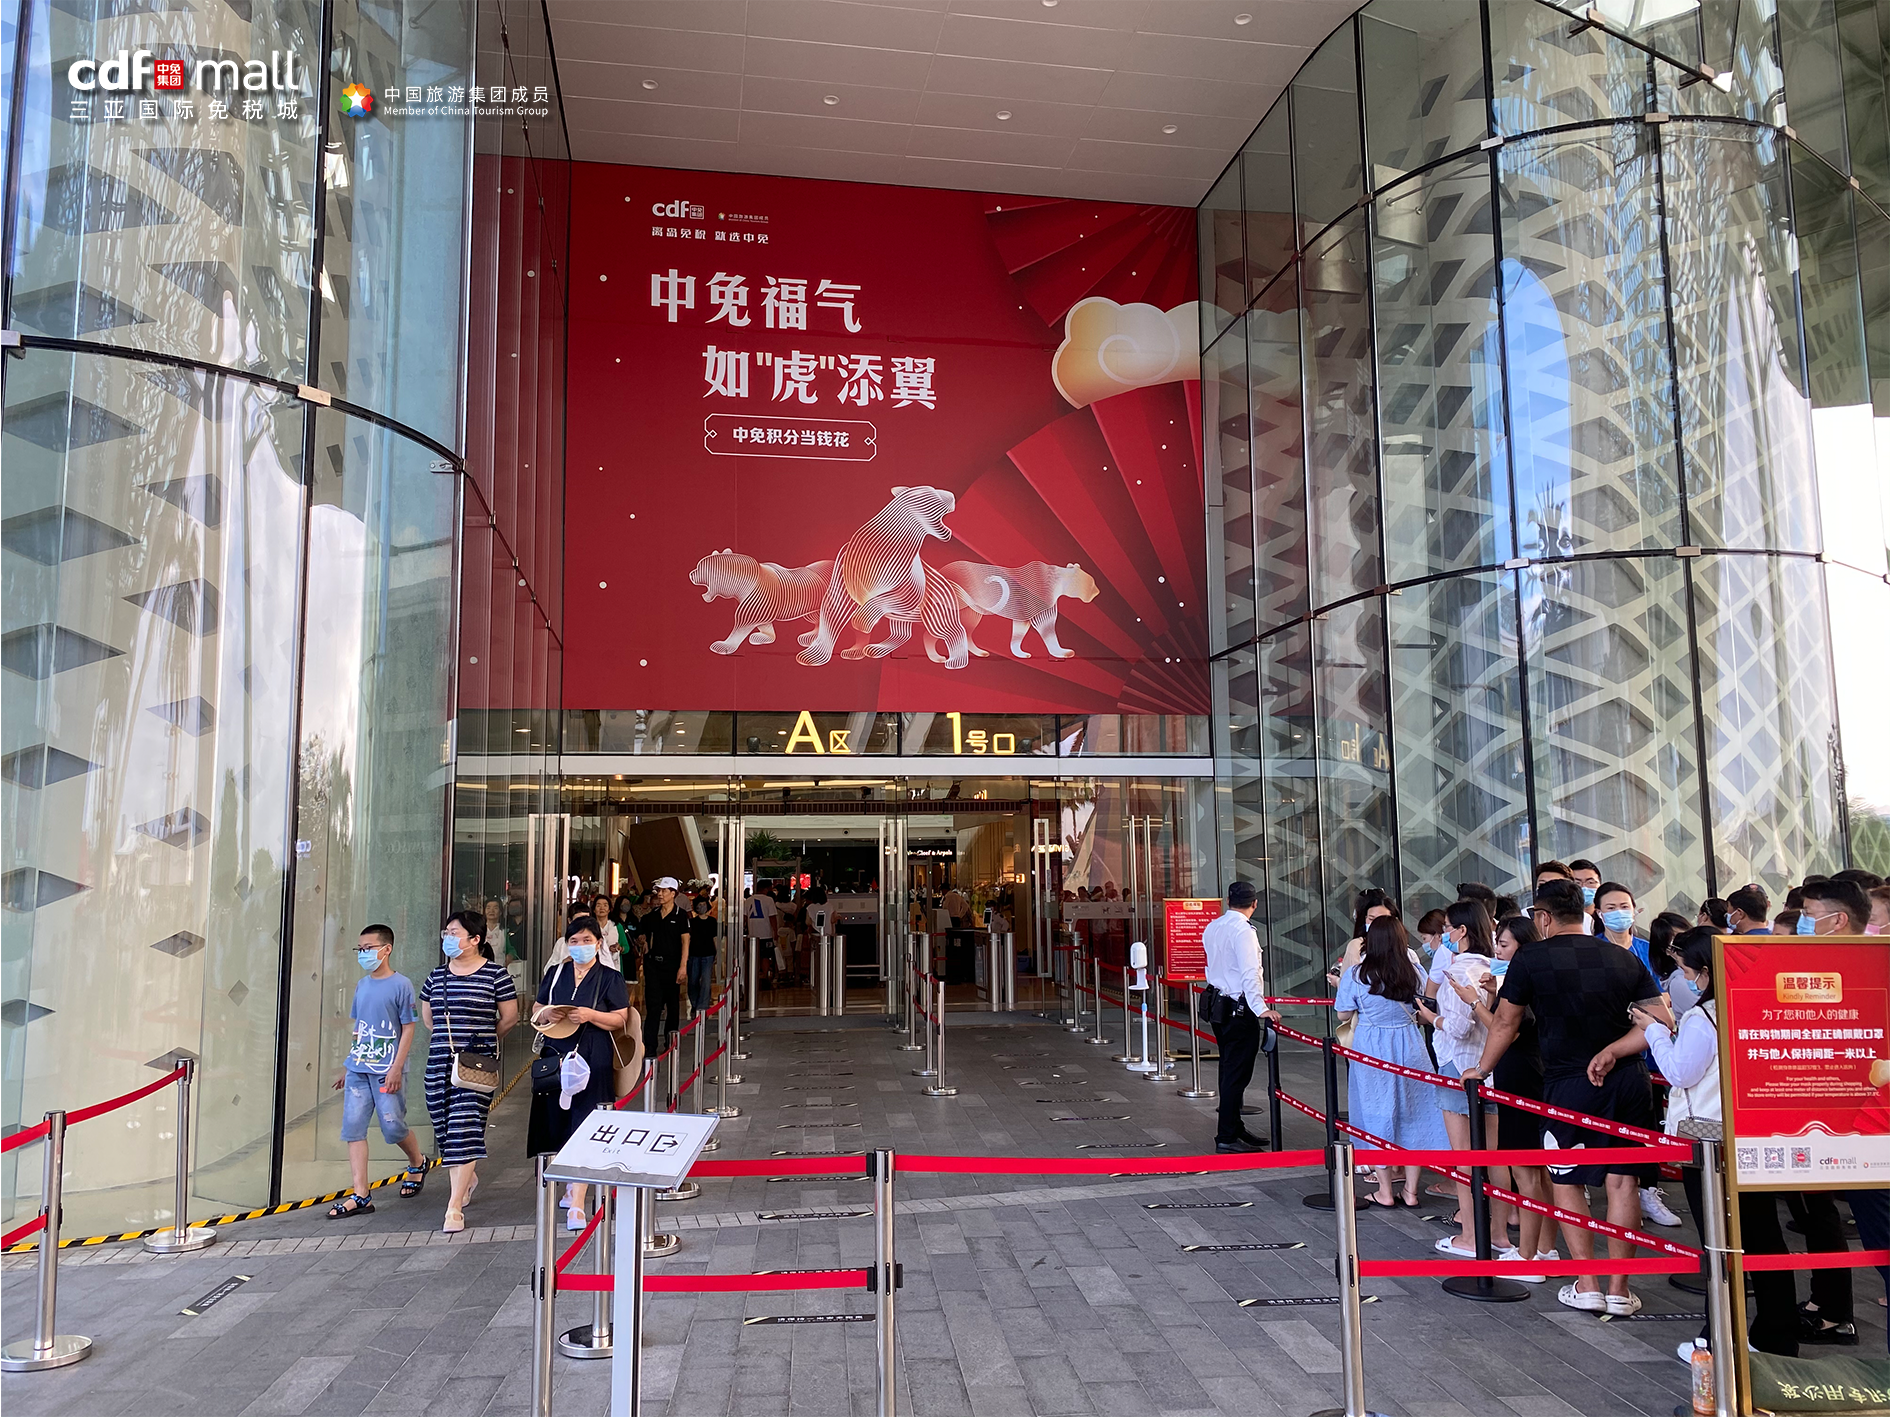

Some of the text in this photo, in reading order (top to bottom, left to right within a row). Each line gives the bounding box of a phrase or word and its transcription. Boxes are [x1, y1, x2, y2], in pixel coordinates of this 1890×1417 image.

[652, 200, 690, 218] cdf
[650, 268, 863, 334] 中免福气
[732, 426, 850, 448] 中免积分当钱花
[785, 710, 1016, 755] A区 1号口
[1783, 977, 1836, 990] 温馨提示
[1782, 993, 1804, 1001] Kindly
[1762, 1009, 1860, 1021] 为了您和他人的健康
[1738, 1028, 1884, 1041] 请在购物期间全程正确佩戴口罩
[1747, 1048, 1877, 1060] 并与他人保持间距一米以上
[589, 1124, 651, 1147] 出口
[602, 1147, 621, 1155] Exit
